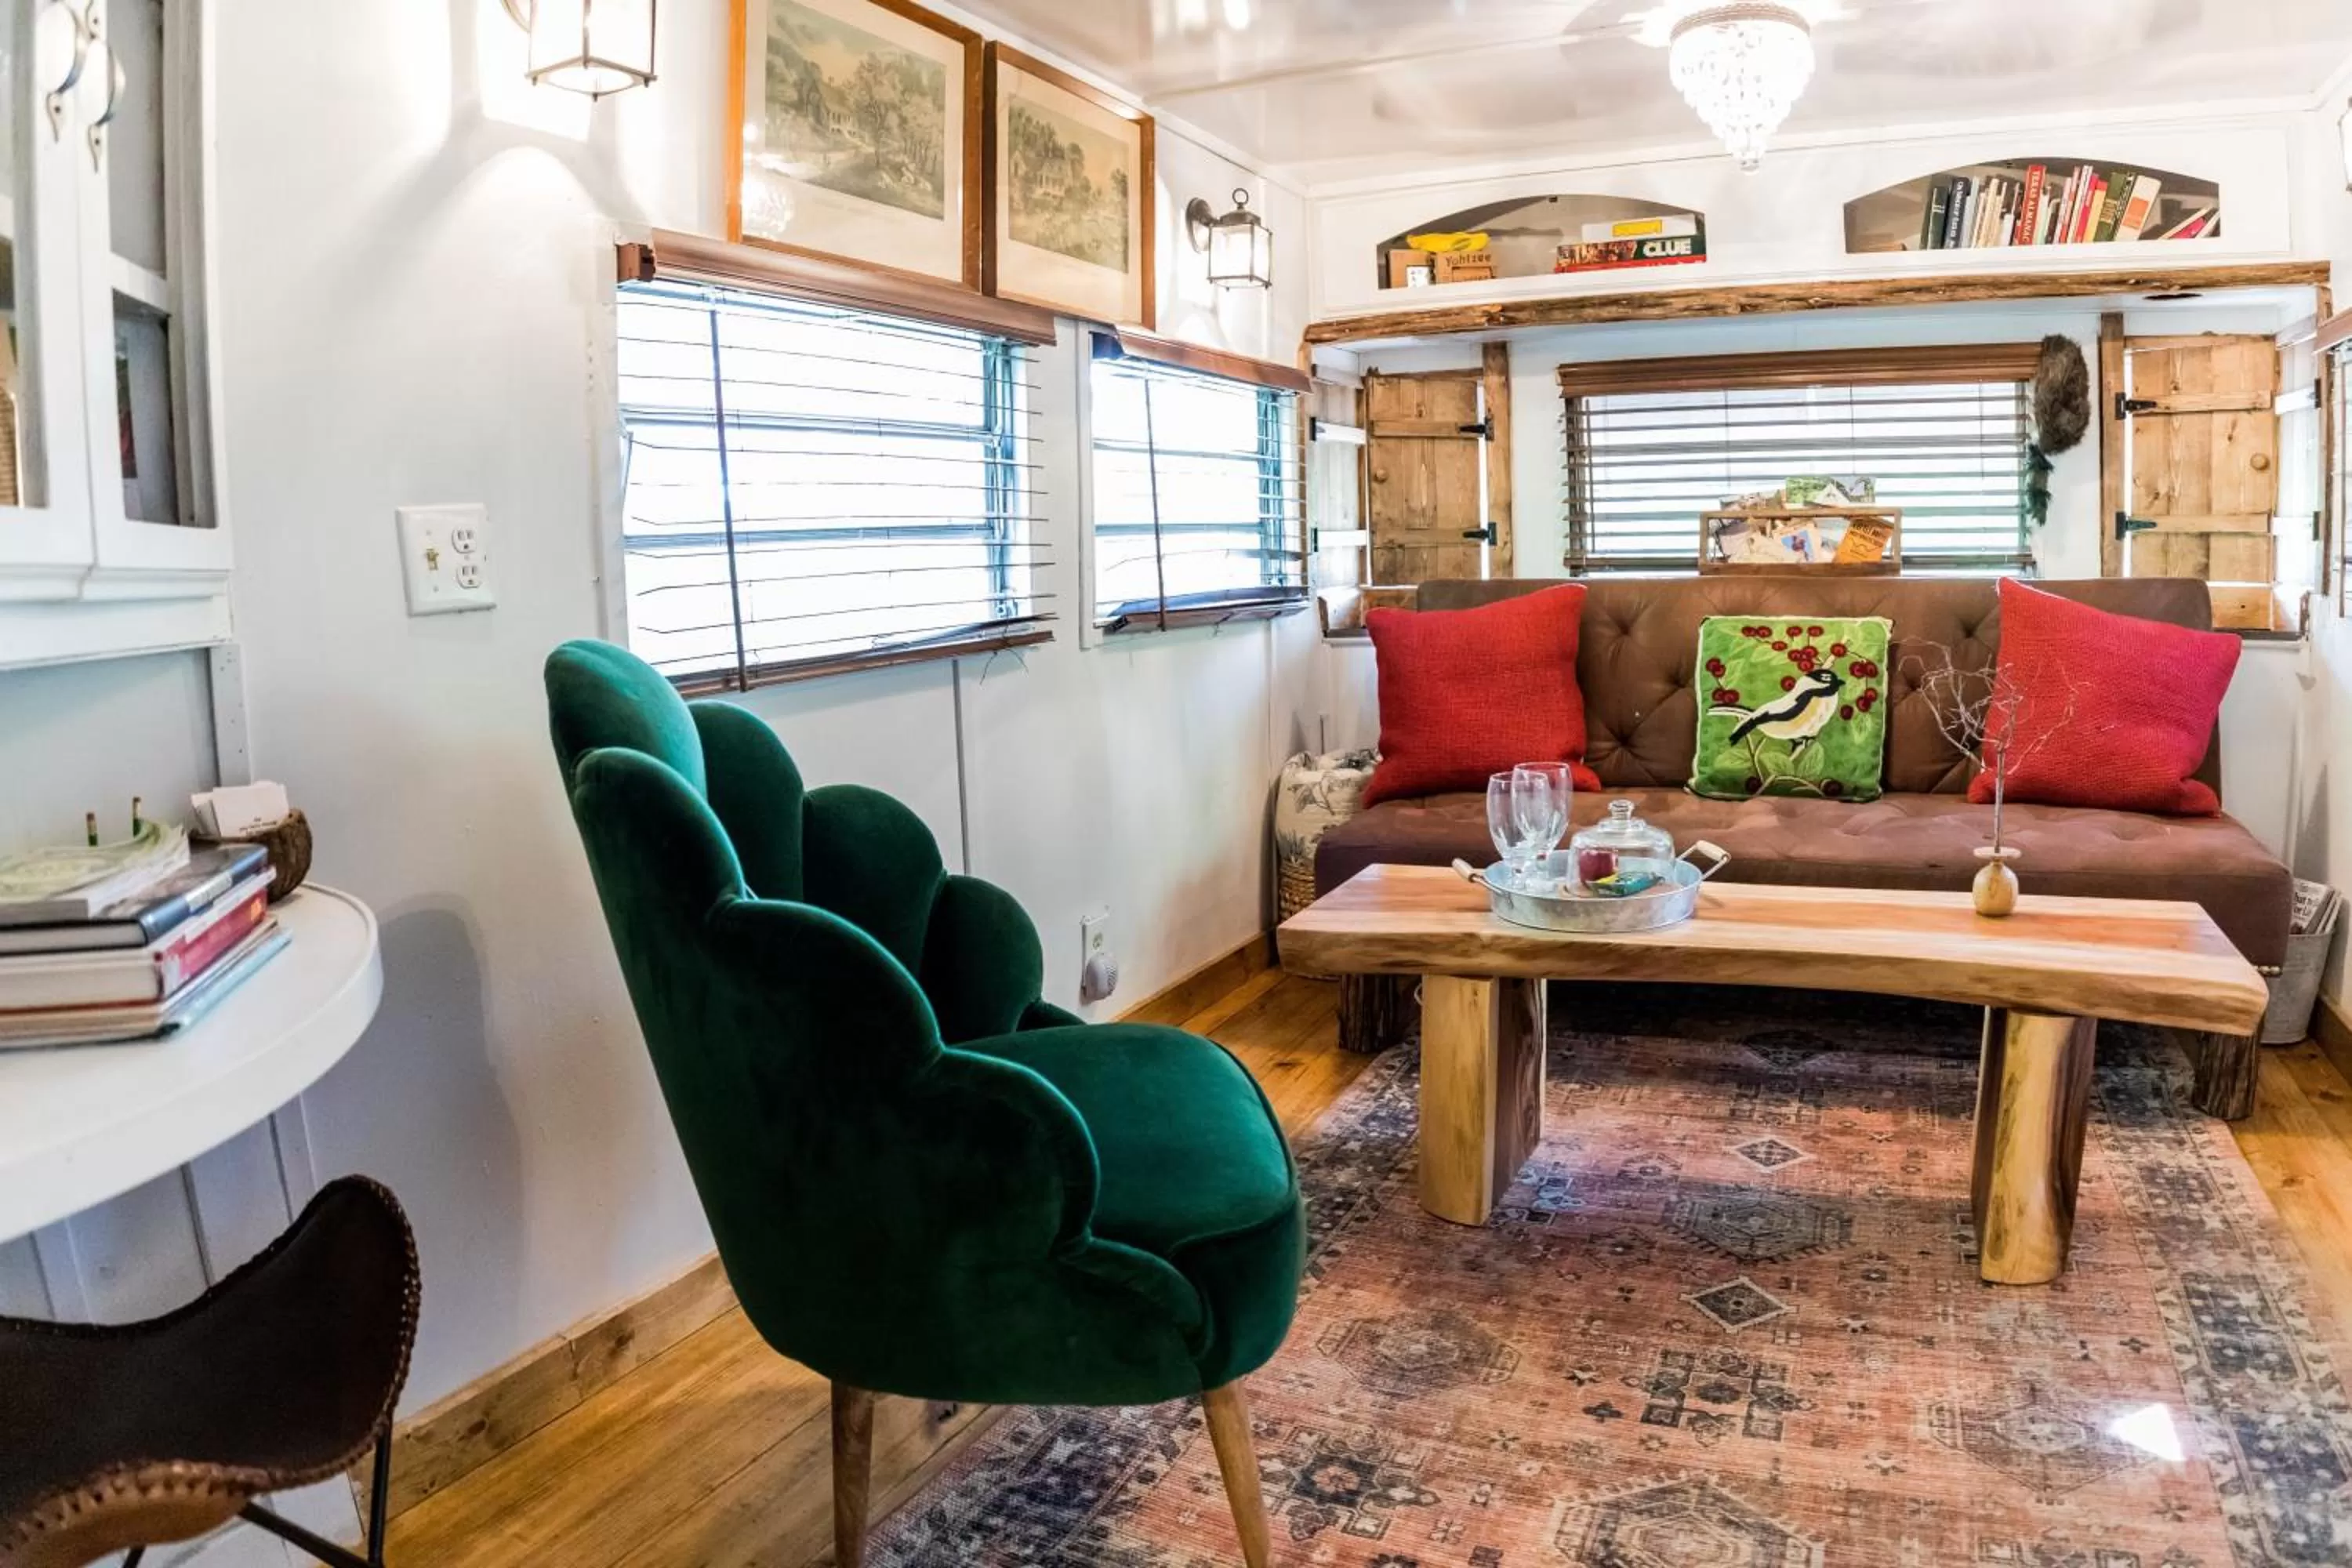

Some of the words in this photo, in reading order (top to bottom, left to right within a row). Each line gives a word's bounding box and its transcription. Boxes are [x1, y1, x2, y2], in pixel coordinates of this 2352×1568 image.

[2031, 170, 2040, 199] TEXAS
[2022, 200, 2035, 243] ALMANAC
[1642, 238, 1693, 256] CLUE
